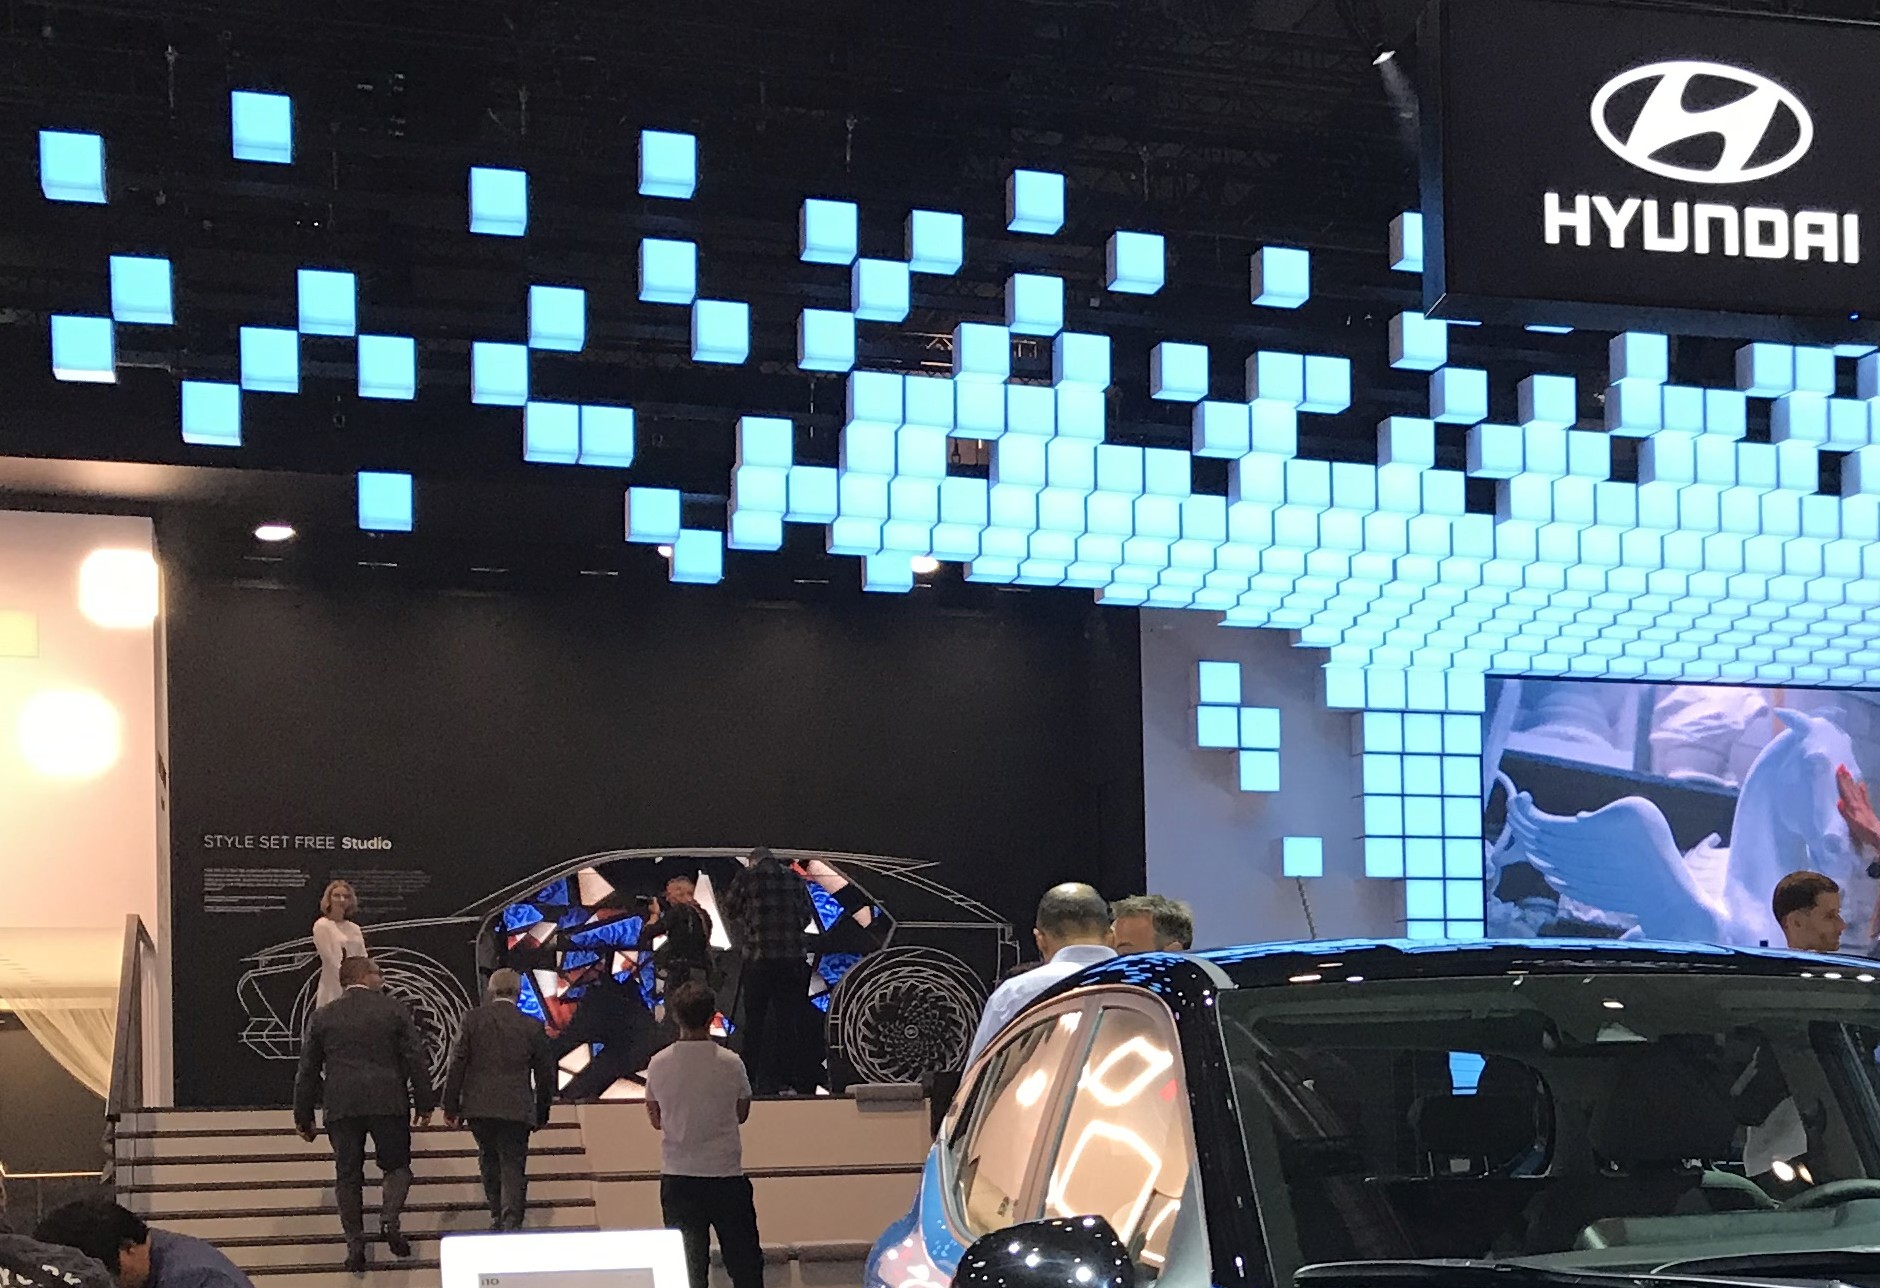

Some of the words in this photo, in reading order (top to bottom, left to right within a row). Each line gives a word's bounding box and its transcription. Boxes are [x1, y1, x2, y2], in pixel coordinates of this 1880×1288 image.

[1544, 191, 1860, 264] HYUNDAI
[204, 835, 254, 849] STYLE
[259, 836, 290, 849] SET
[294, 837, 335, 849] FREE
[341, 837, 392, 850] Studio
[481, 1278, 500, 1286] i10
